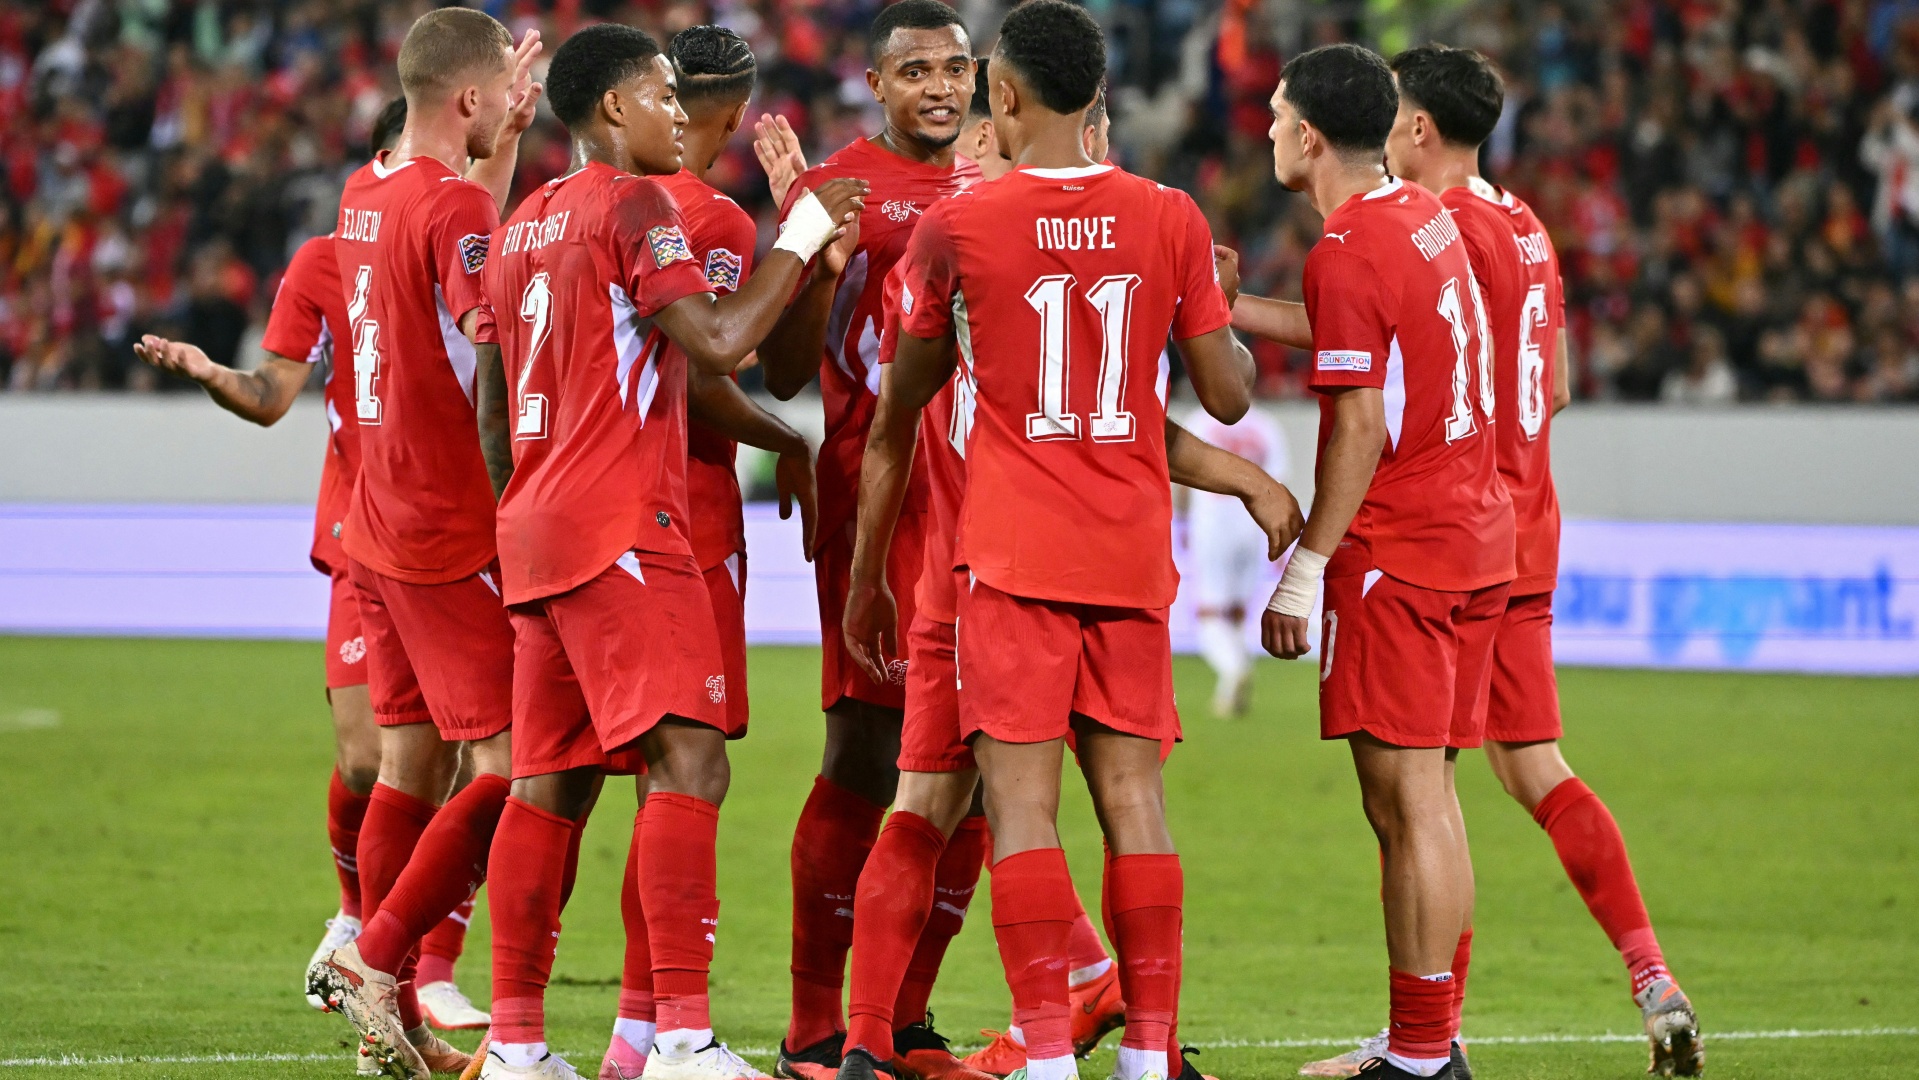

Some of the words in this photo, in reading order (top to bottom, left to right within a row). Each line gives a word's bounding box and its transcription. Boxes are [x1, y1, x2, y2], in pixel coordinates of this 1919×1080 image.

[341, 208, 382, 243] ELVEDI
[1036, 216, 1116, 250] NDOYE
[347, 266, 382, 425] 4
[515, 272, 553, 441] 2
[1024, 274, 1141, 443] 11
[1318, 356, 1370, 365] FOUNDATION
[1518, 283, 1549, 442] 6
